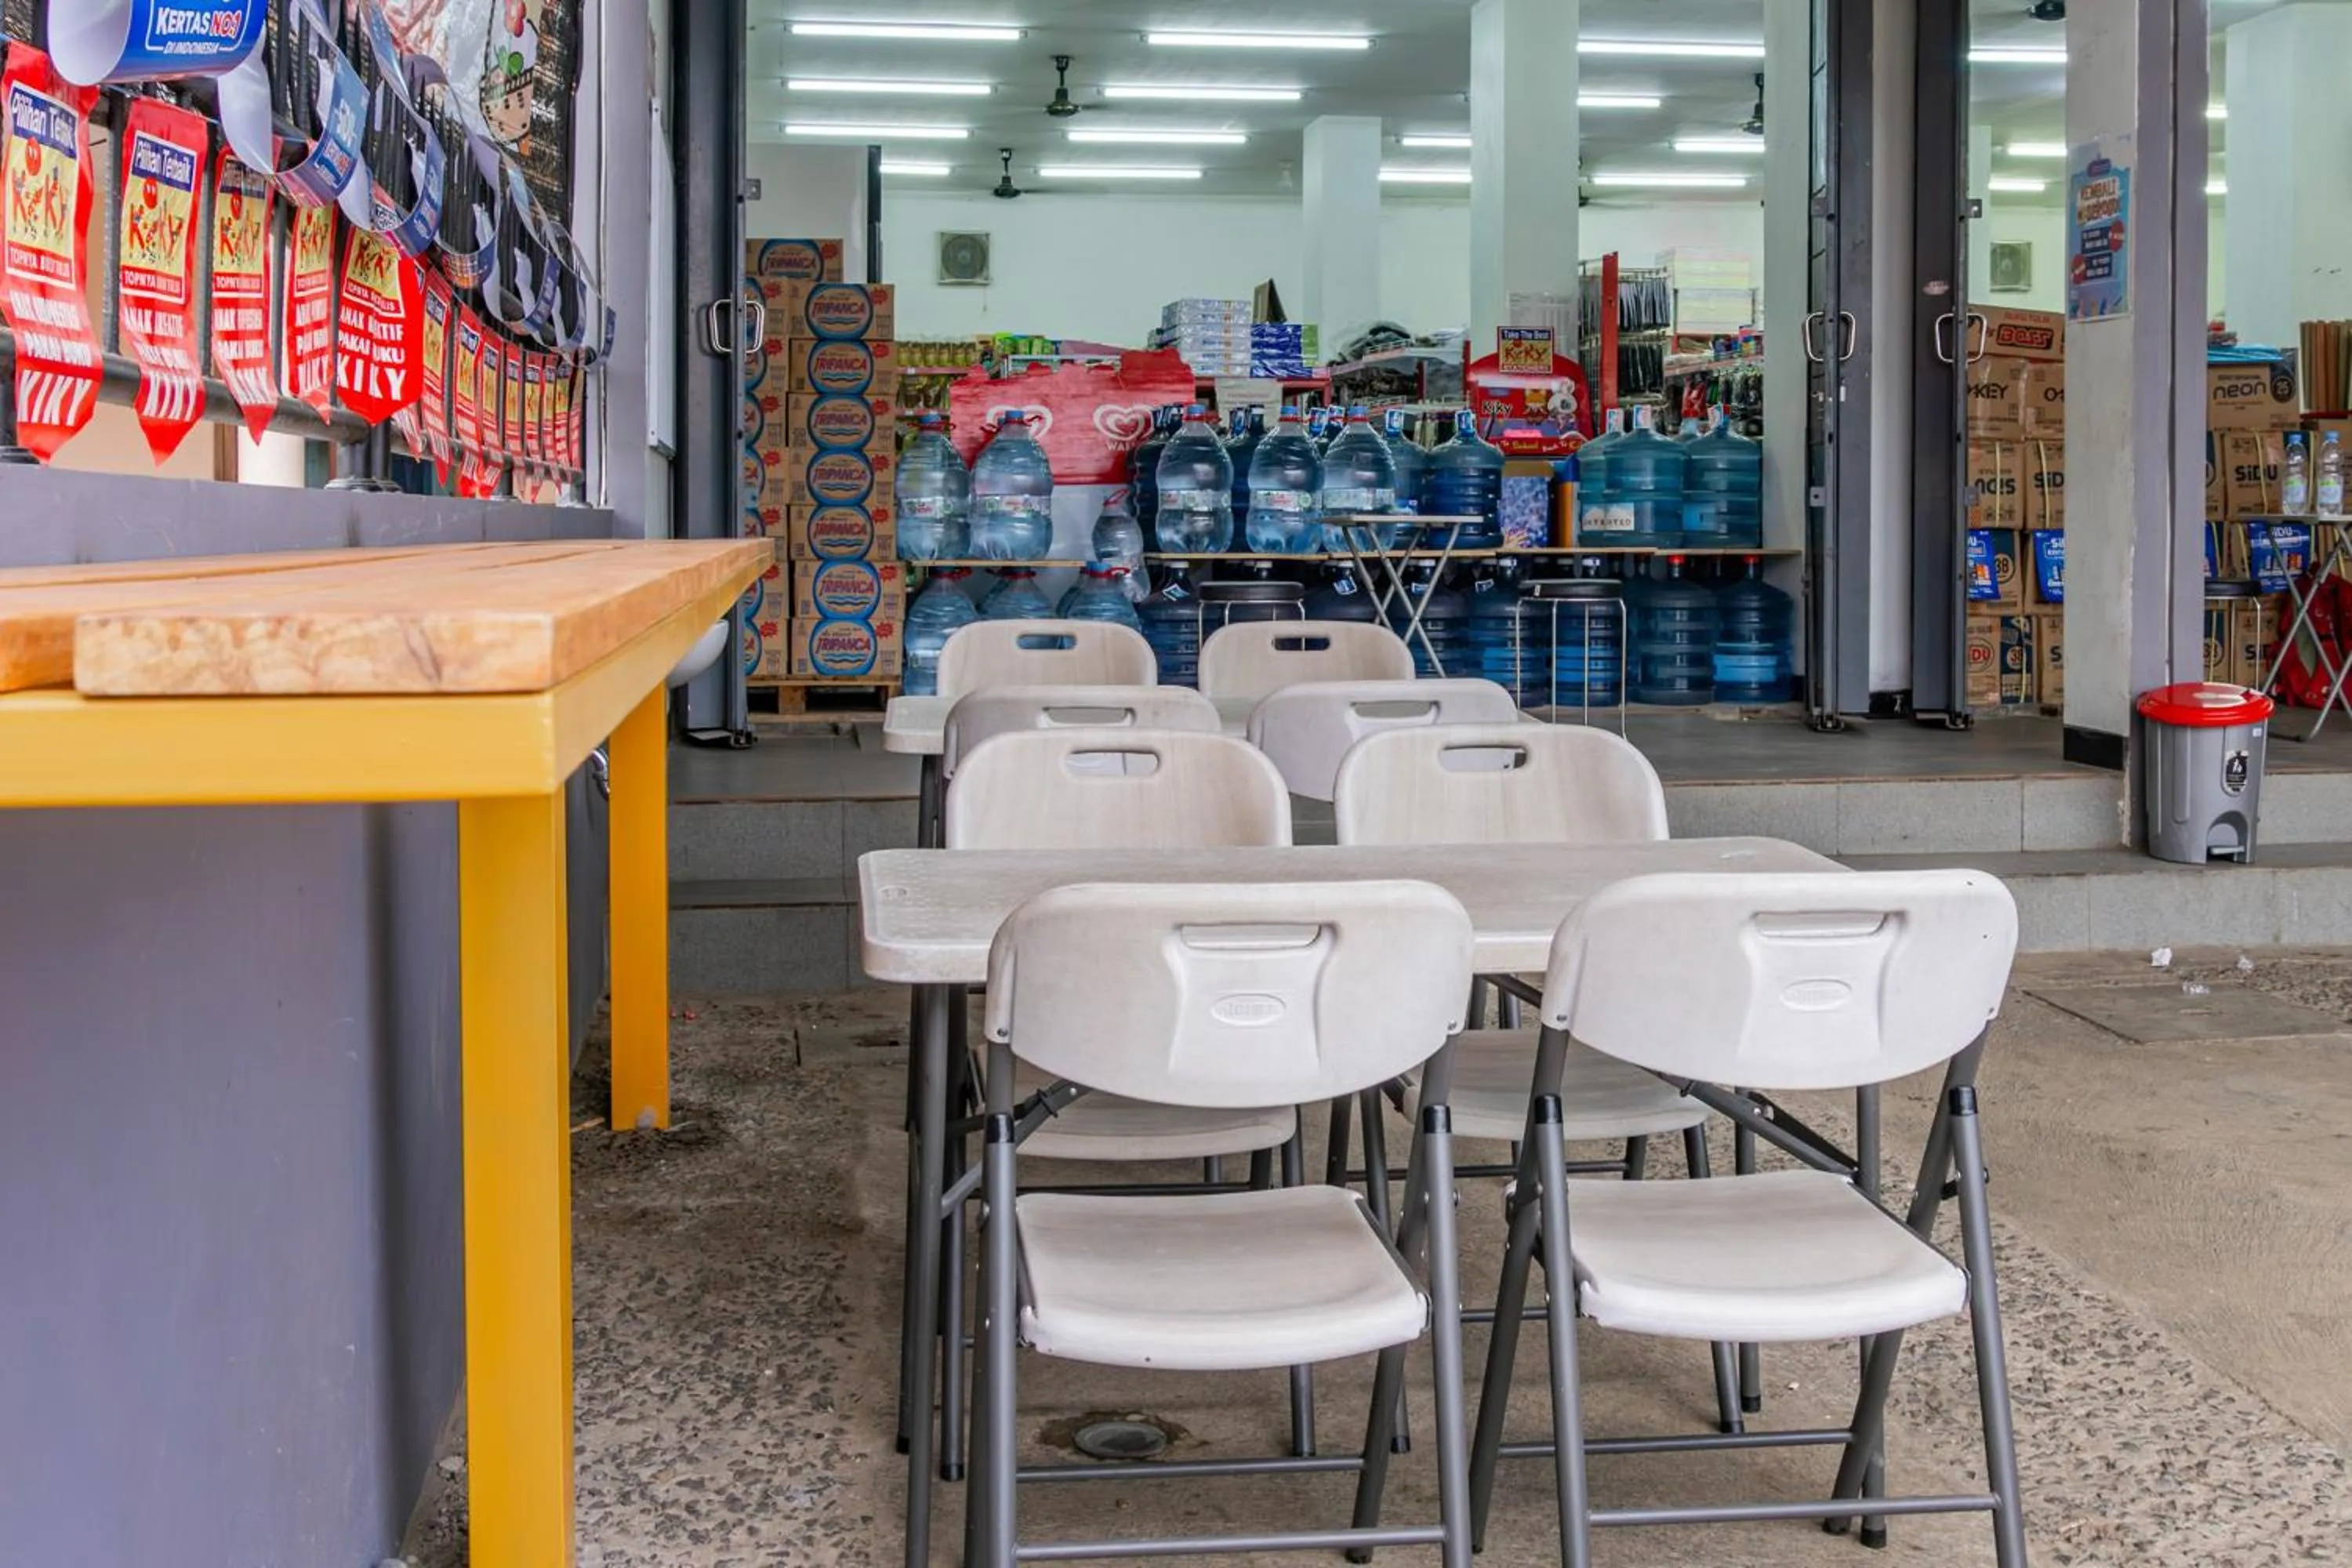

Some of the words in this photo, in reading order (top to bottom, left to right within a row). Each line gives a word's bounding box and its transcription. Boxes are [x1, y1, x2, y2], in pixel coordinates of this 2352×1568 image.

[156, 7, 210, 34] KERTAS
[811, 302, 866, 318] TRIPANCA
[338, 329, 370, 355] PAKAI
[1504, 330, 1519, 339] Take
[1521, 330, 1533, 339] The
[2000, 327, 2051, 347] BOSS
[814, 358, 867, 373] TRIPANCA
[336, 352, 406, 401] KIKY
[17, 369, 93, 426] KIKY
[2213, 382, 2267, 401] neon
[814, 413, 867, 429] TRIPANCA
[812, 468, 868, 484] TRIPANCA
[2034, 472, 2064, 488] SiD
[2235, 463, 2278, 482] SiDU
[813, 523, 867, 539] TRIPANCA
[819, 580, 874, 597] TRIPANCA
[815, 637, 871, 654] TRIPANCA
